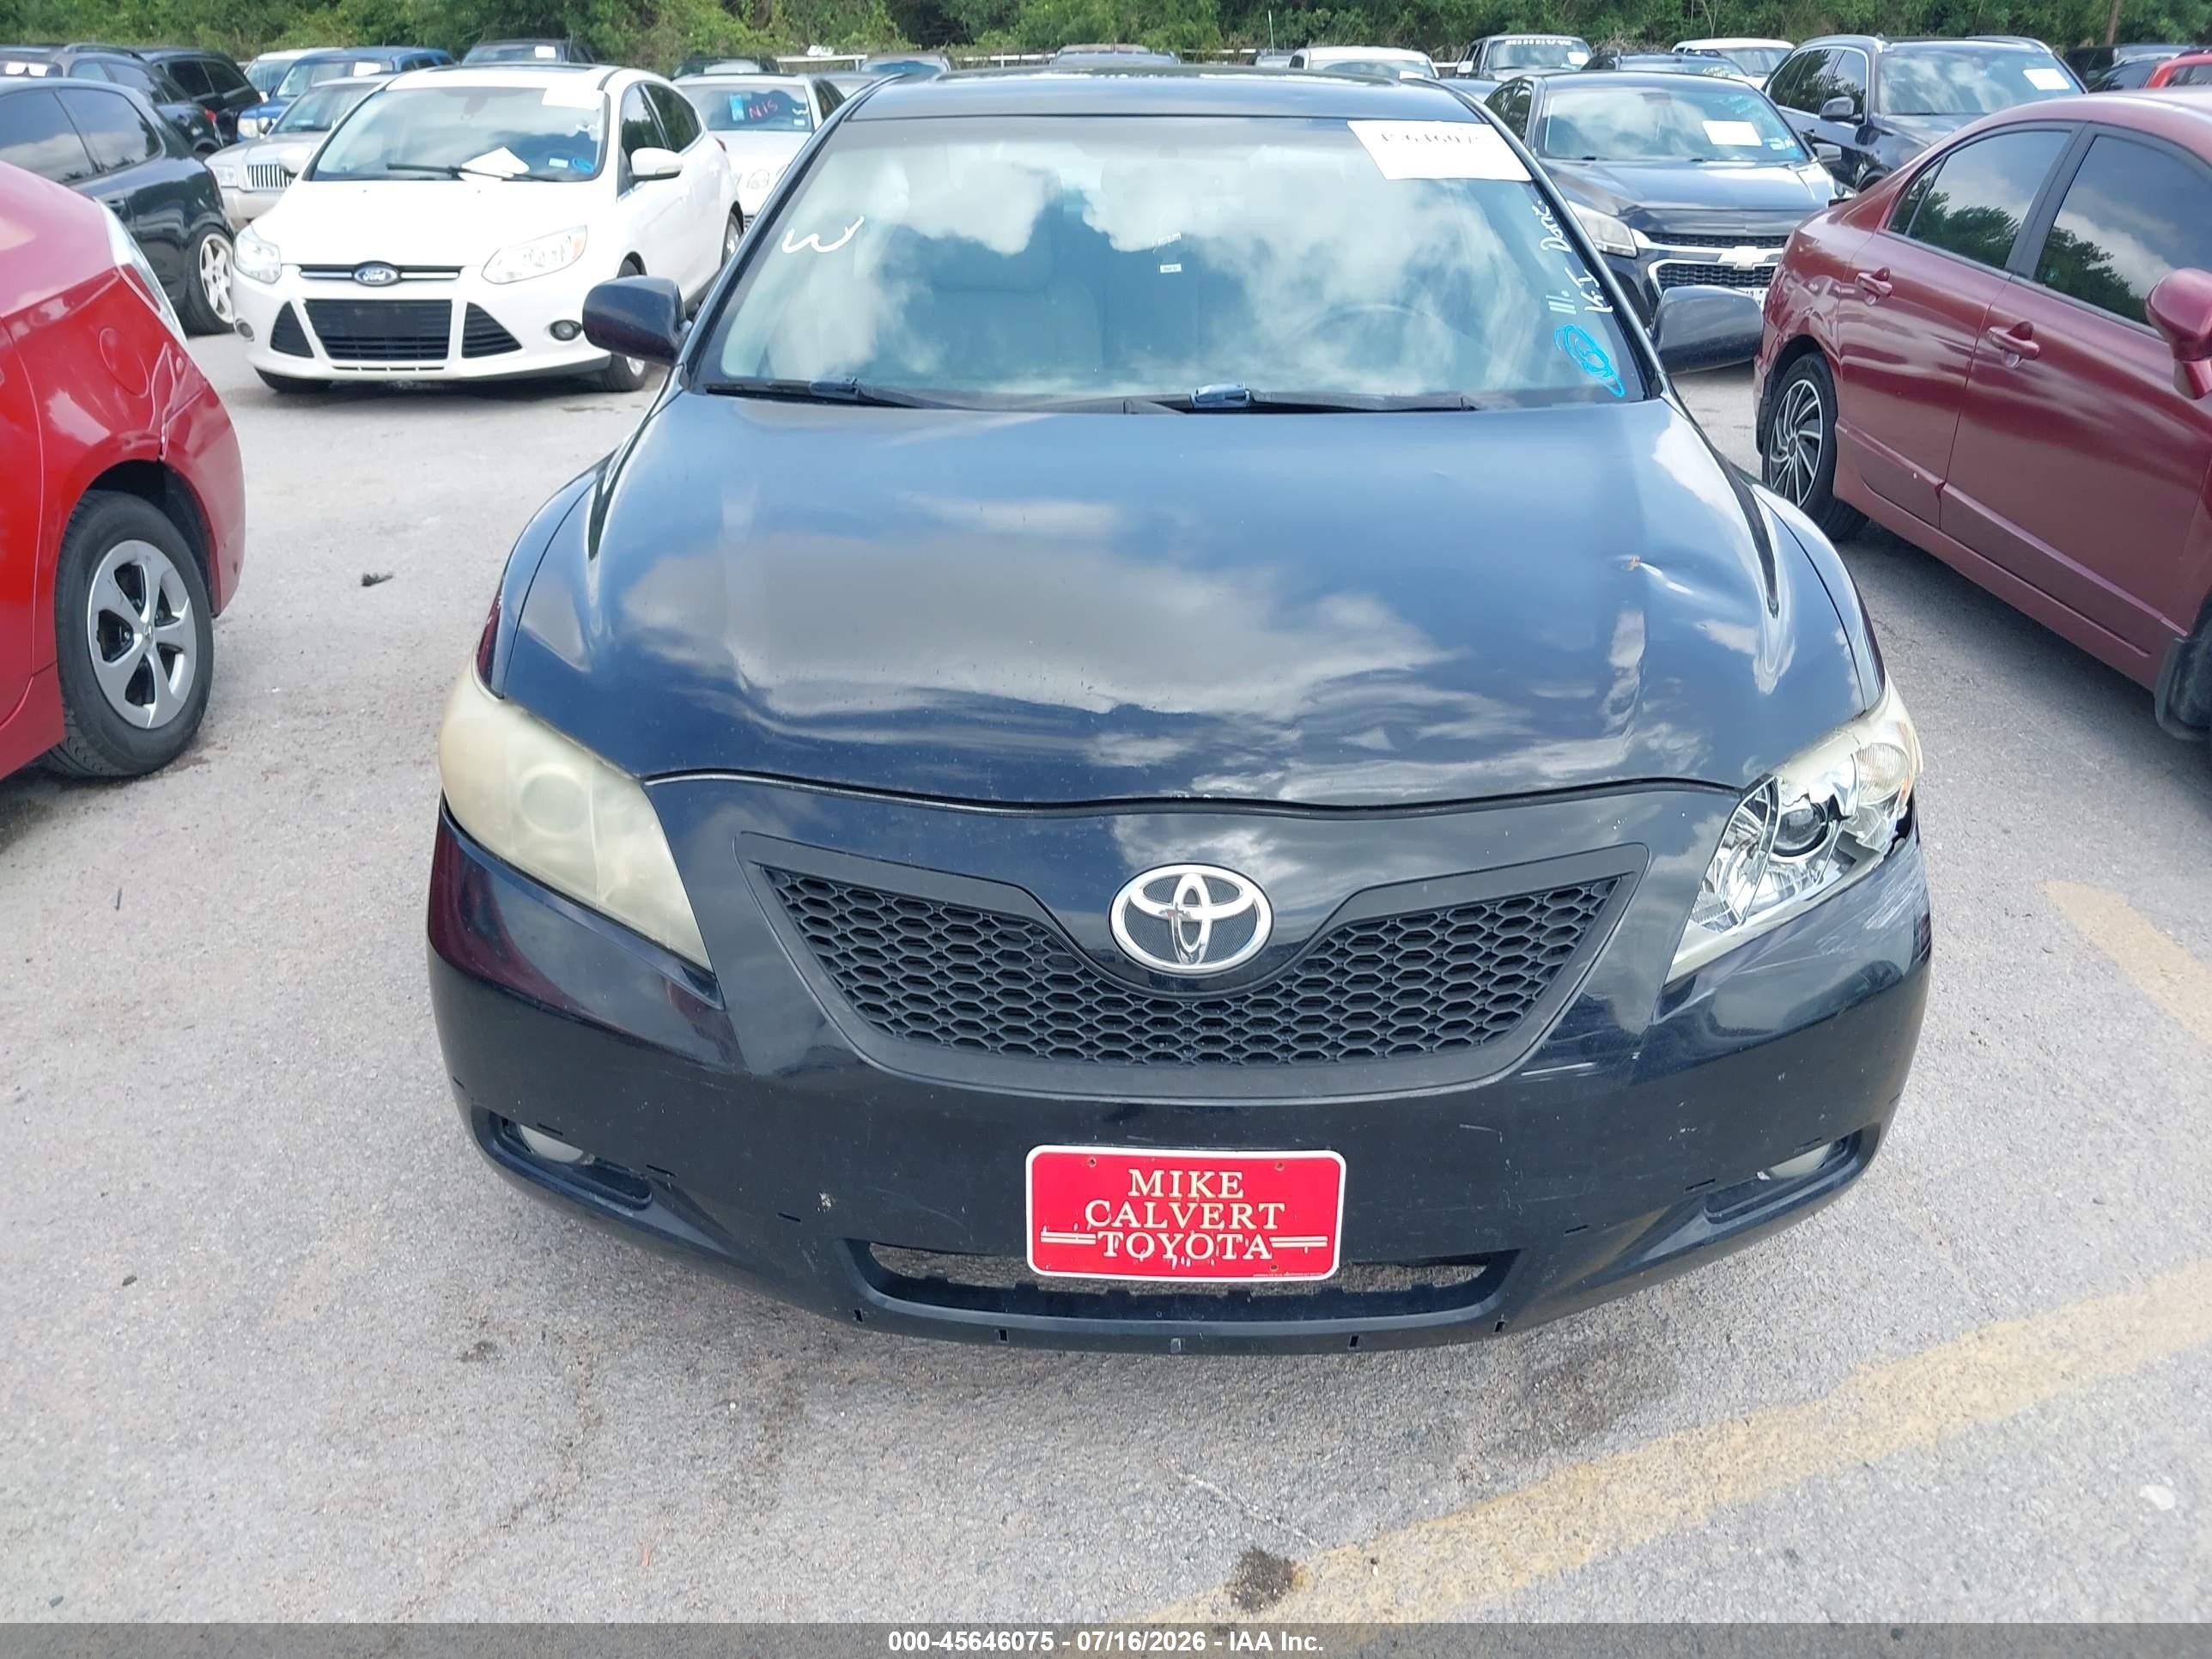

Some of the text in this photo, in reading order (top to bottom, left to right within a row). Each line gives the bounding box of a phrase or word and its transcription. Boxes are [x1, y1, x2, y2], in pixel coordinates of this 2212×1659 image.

[1127, 1168, 1244, 1199] MIKE
[1085, 1199, 1285, 1231] CALVERT
[1097, 1230, 1273, 1261] TOYOTA
